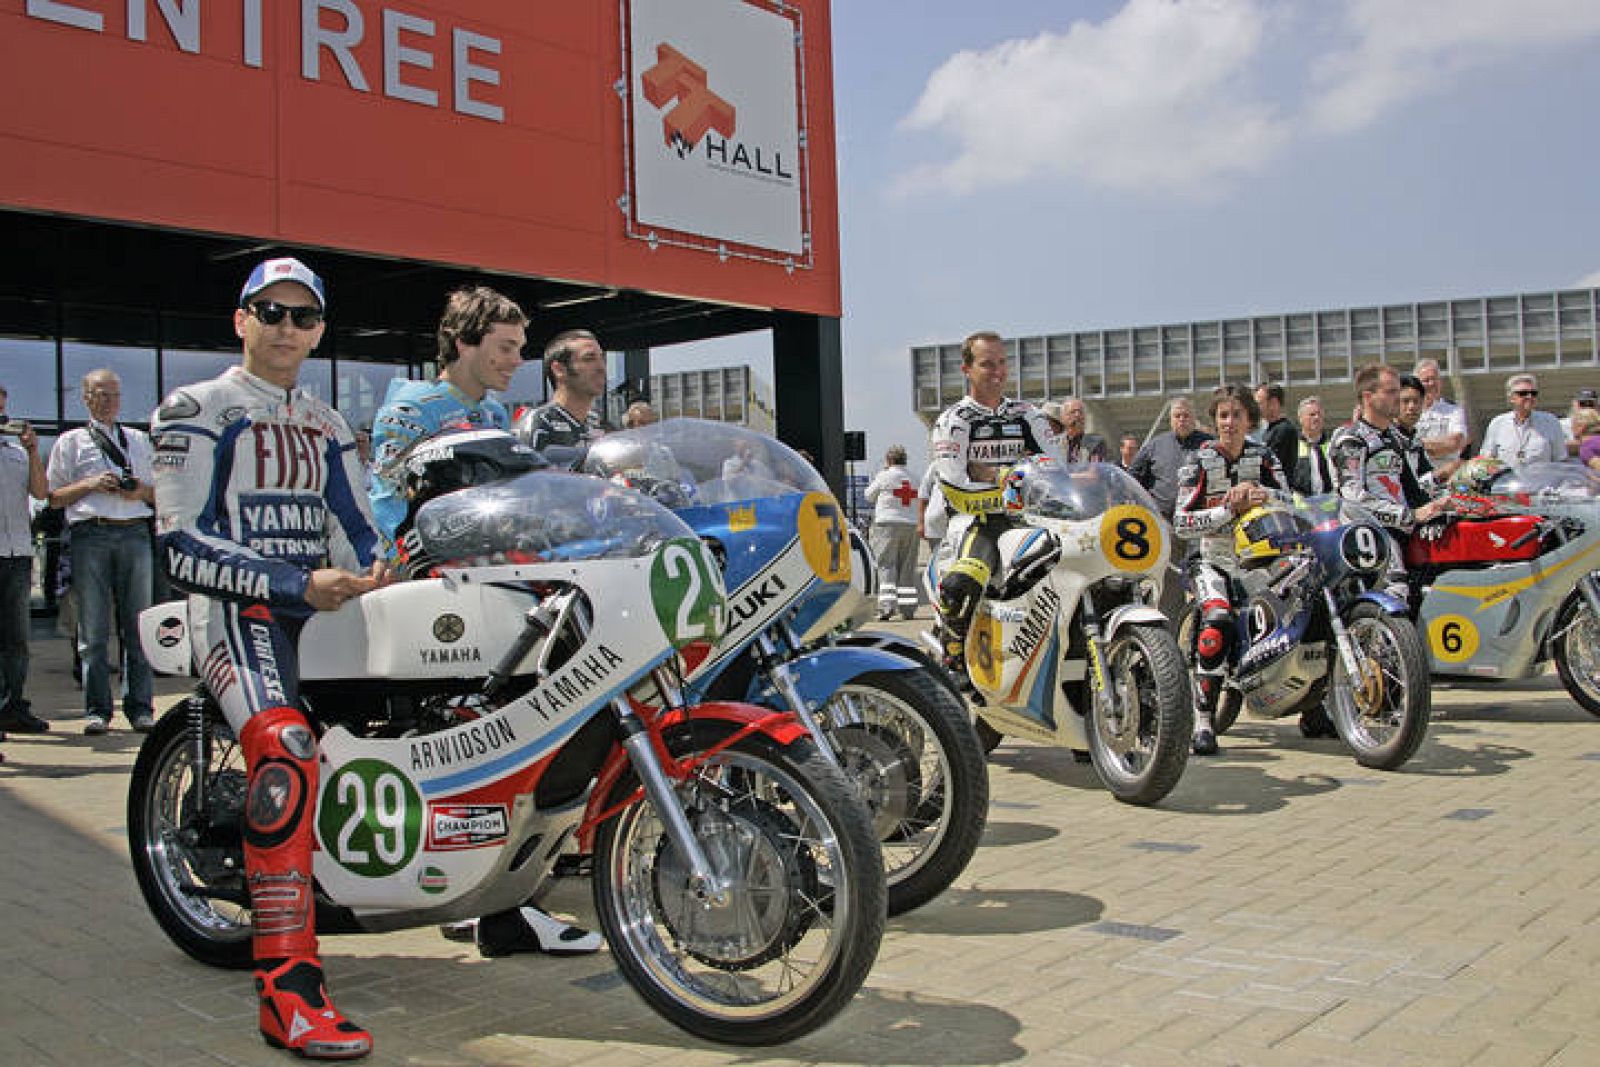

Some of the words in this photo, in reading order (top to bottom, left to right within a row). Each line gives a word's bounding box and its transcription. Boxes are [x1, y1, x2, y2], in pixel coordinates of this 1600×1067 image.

[706, 132, 792, 179] HALL
[251, 421, 322, 492] FIAT
[814, 504, 843, 573] 7
[1115, 517, 1150, 561] 8
[1355, 528, 1377, 568] 9
[168, 547, 270, 600] YAMAHA
[1008, 586, 1061, 661] YAMAHA
[1441, 621, 1463, 654] 6
[420, 648, 481, 664] YAMAHA
[409, 715, 517, 771] ARWIDSON
[527, 644, 623, 721] YAMAHA
[337, 770, 406, 866] 29
[437, 818, 502, 834] CHAMPION
